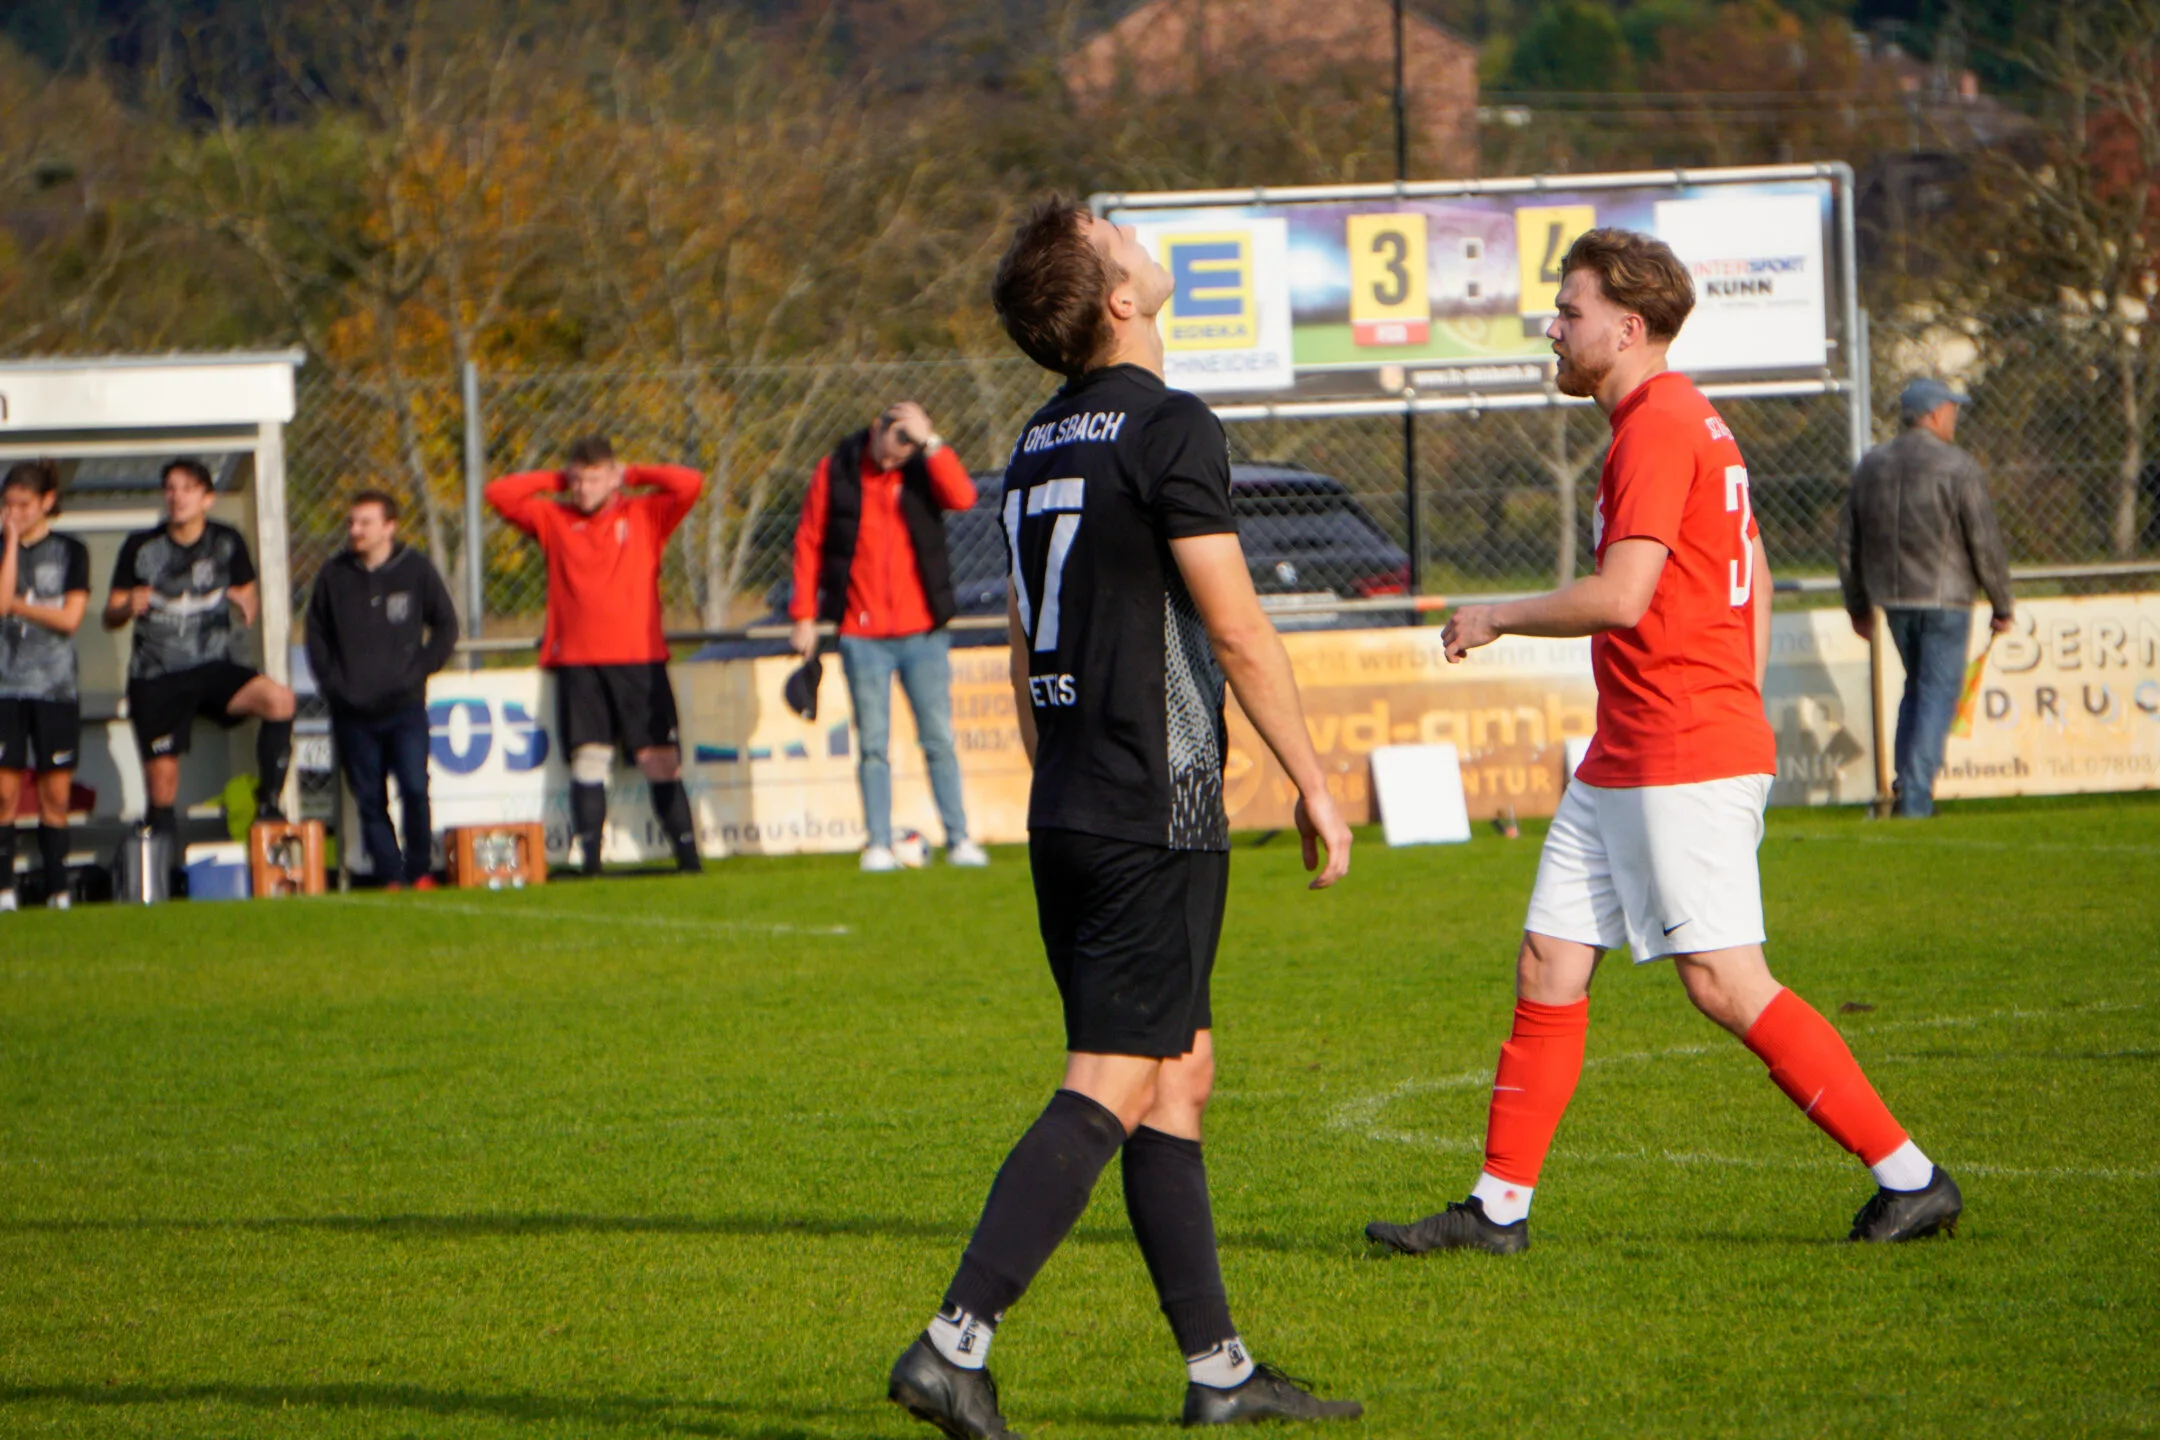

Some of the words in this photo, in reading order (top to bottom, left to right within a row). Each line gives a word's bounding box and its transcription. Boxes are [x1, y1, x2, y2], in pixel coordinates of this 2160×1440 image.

[1371, 230, 1411, 306] 3
[1165, 352, 1280, 373] CHNEIDER
[1024, 411, 1126, 453] OHLSBACH
[1003, 478, 1084, 652] 17
[1724, 464, 1754, 607] 3
